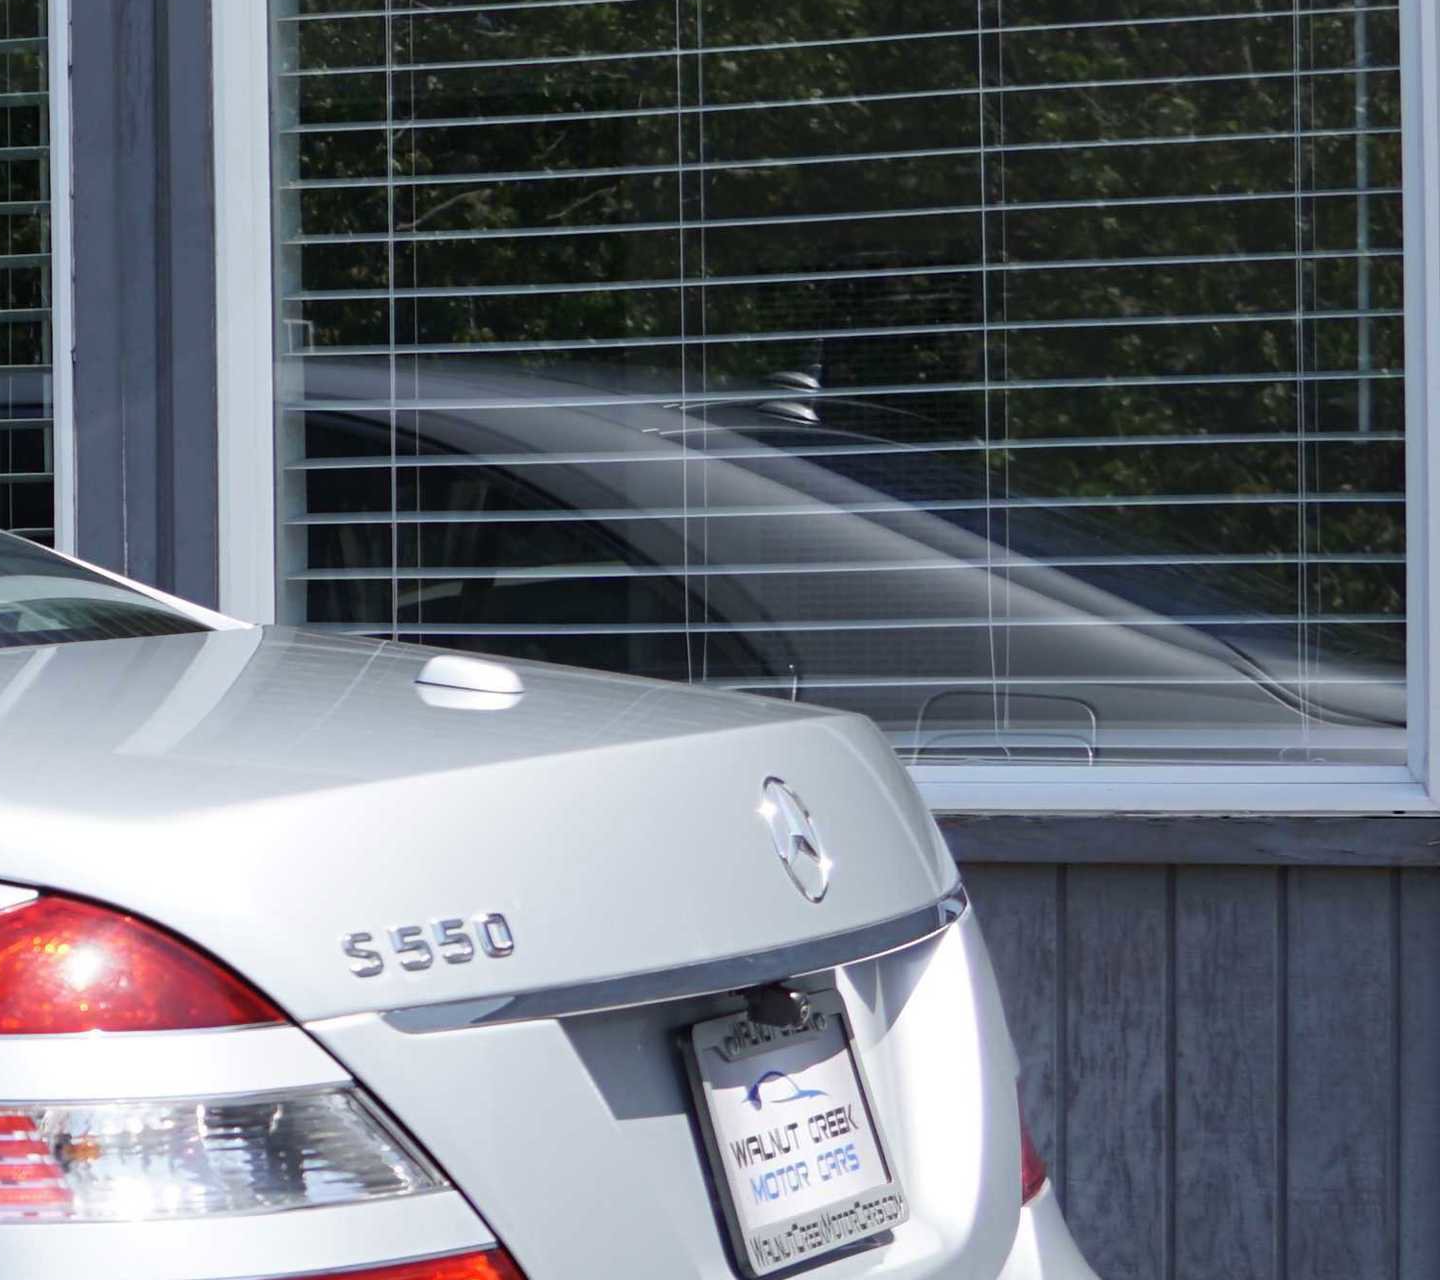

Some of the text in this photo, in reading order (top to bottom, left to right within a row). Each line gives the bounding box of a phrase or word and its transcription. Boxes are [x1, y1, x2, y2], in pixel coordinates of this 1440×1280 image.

[730, 1104, 859, 1169] WALNUT CREEK
[750, 1144, 860, 1206] MOTOR CARS
